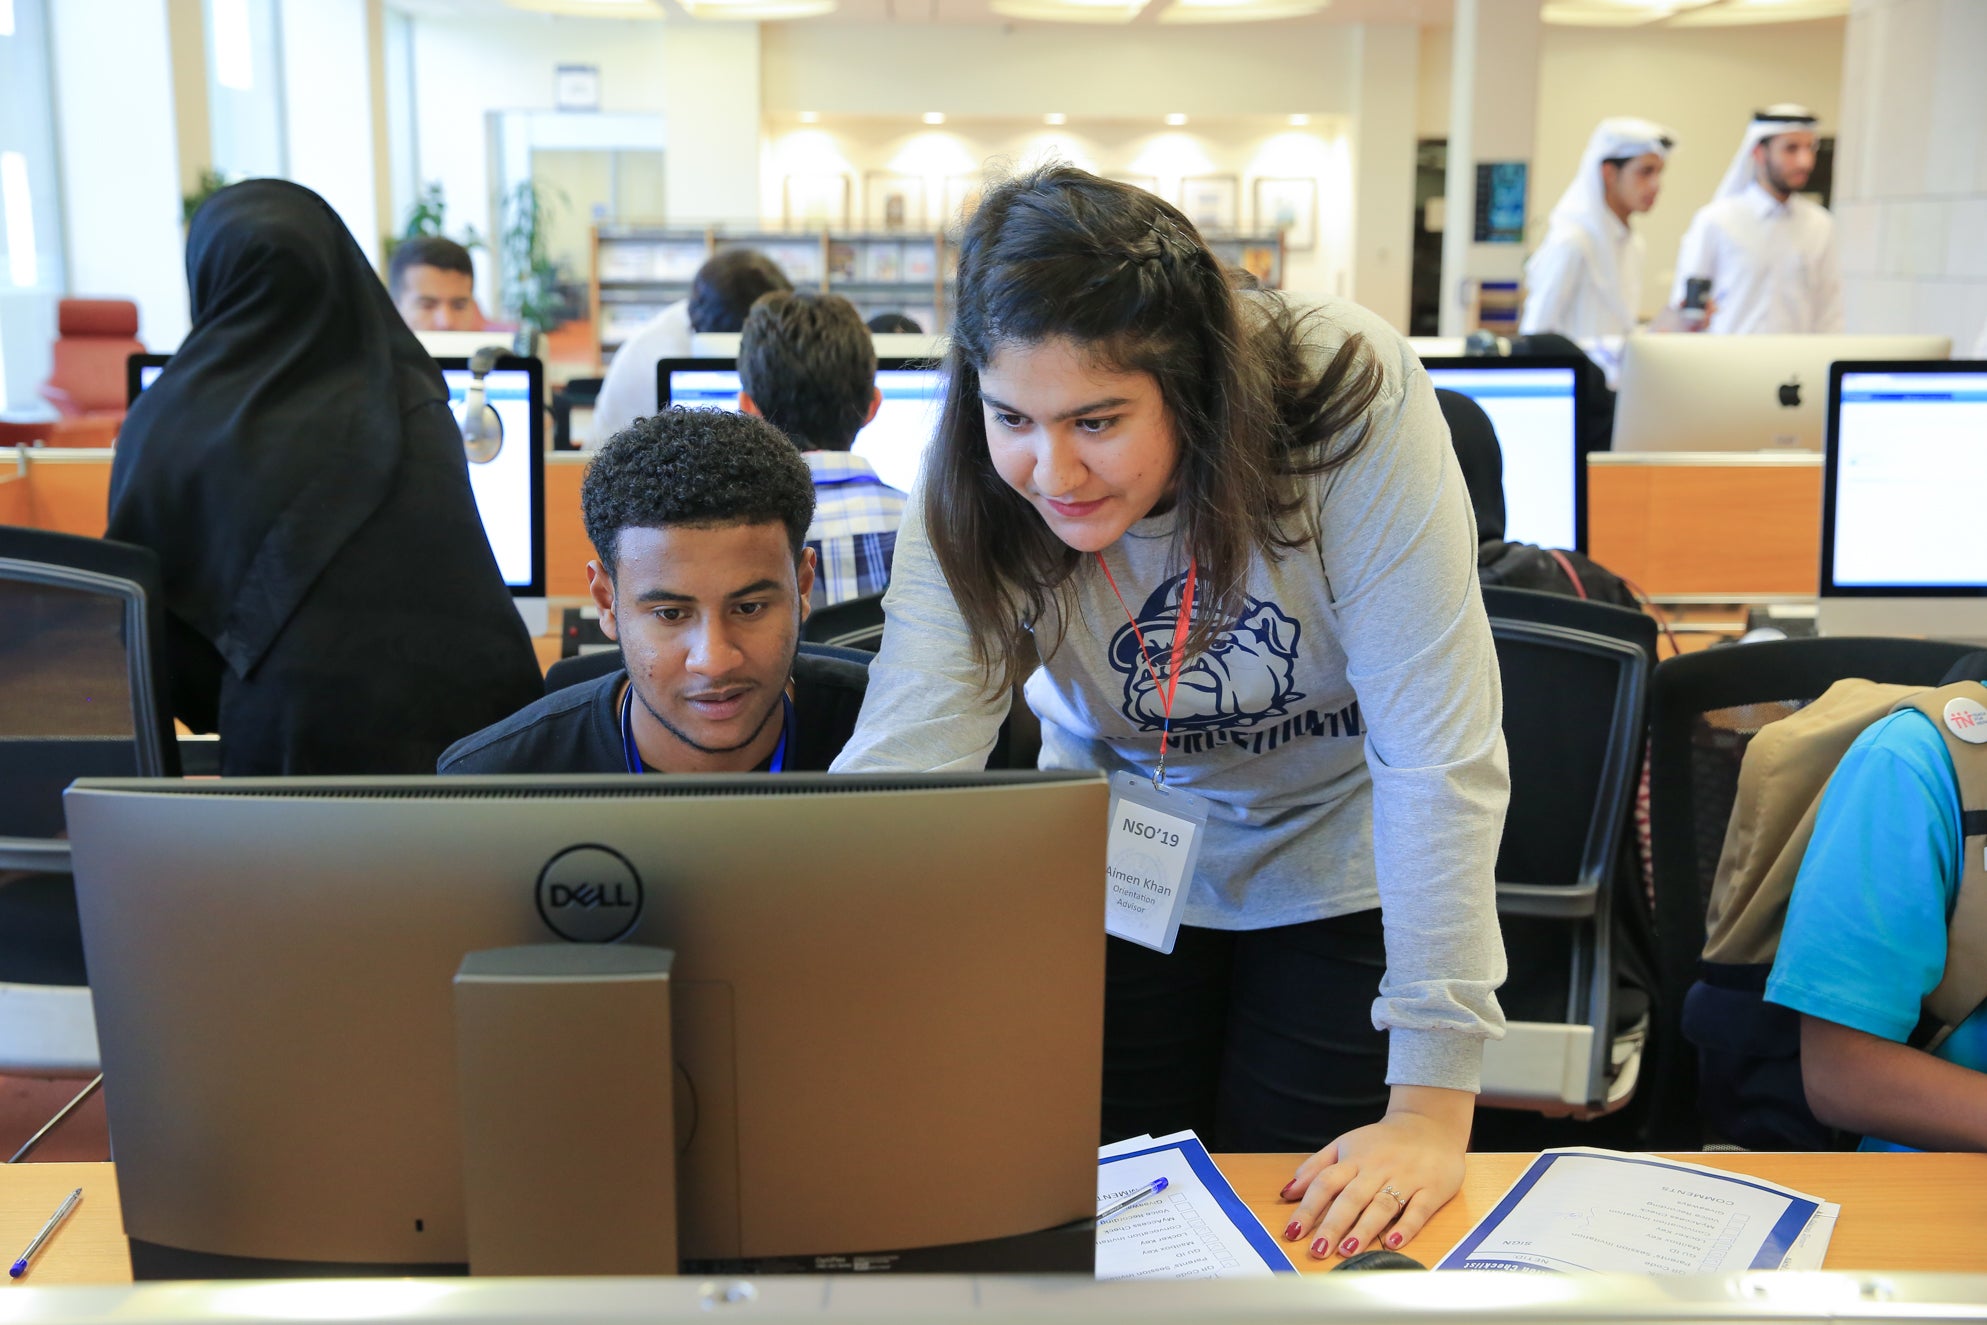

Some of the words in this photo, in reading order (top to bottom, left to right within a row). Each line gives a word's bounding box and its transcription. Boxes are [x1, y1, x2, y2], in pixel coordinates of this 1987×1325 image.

[1106, 865, 1141, 886] Aimen
[1143, 878, 1172, 897] Khan
[550, 882, 633, 908] DELL
[1112, 884, 1156, 905] Orientation
[1116, 898, 1146, 914] Advisor
[1661, 1186, 1735, 1206] COMMENTS
[1145, 1208, 1171, 1217] Voice
[1099, 1213, 1144, 1226] Recording
[1103, 1224, 1132, 1235] Check
[1139, 1238, 1156, 1246] Key
[1158, 1232, 1188, 1242] Locker
[1141, 1248, 1158, 1256] Key
[1158, 1240, 1195, 1252] Mailbox
[1136, 1265, 1171, 1277] Session
[1463, 1262, 1519, 1271] Checklist
